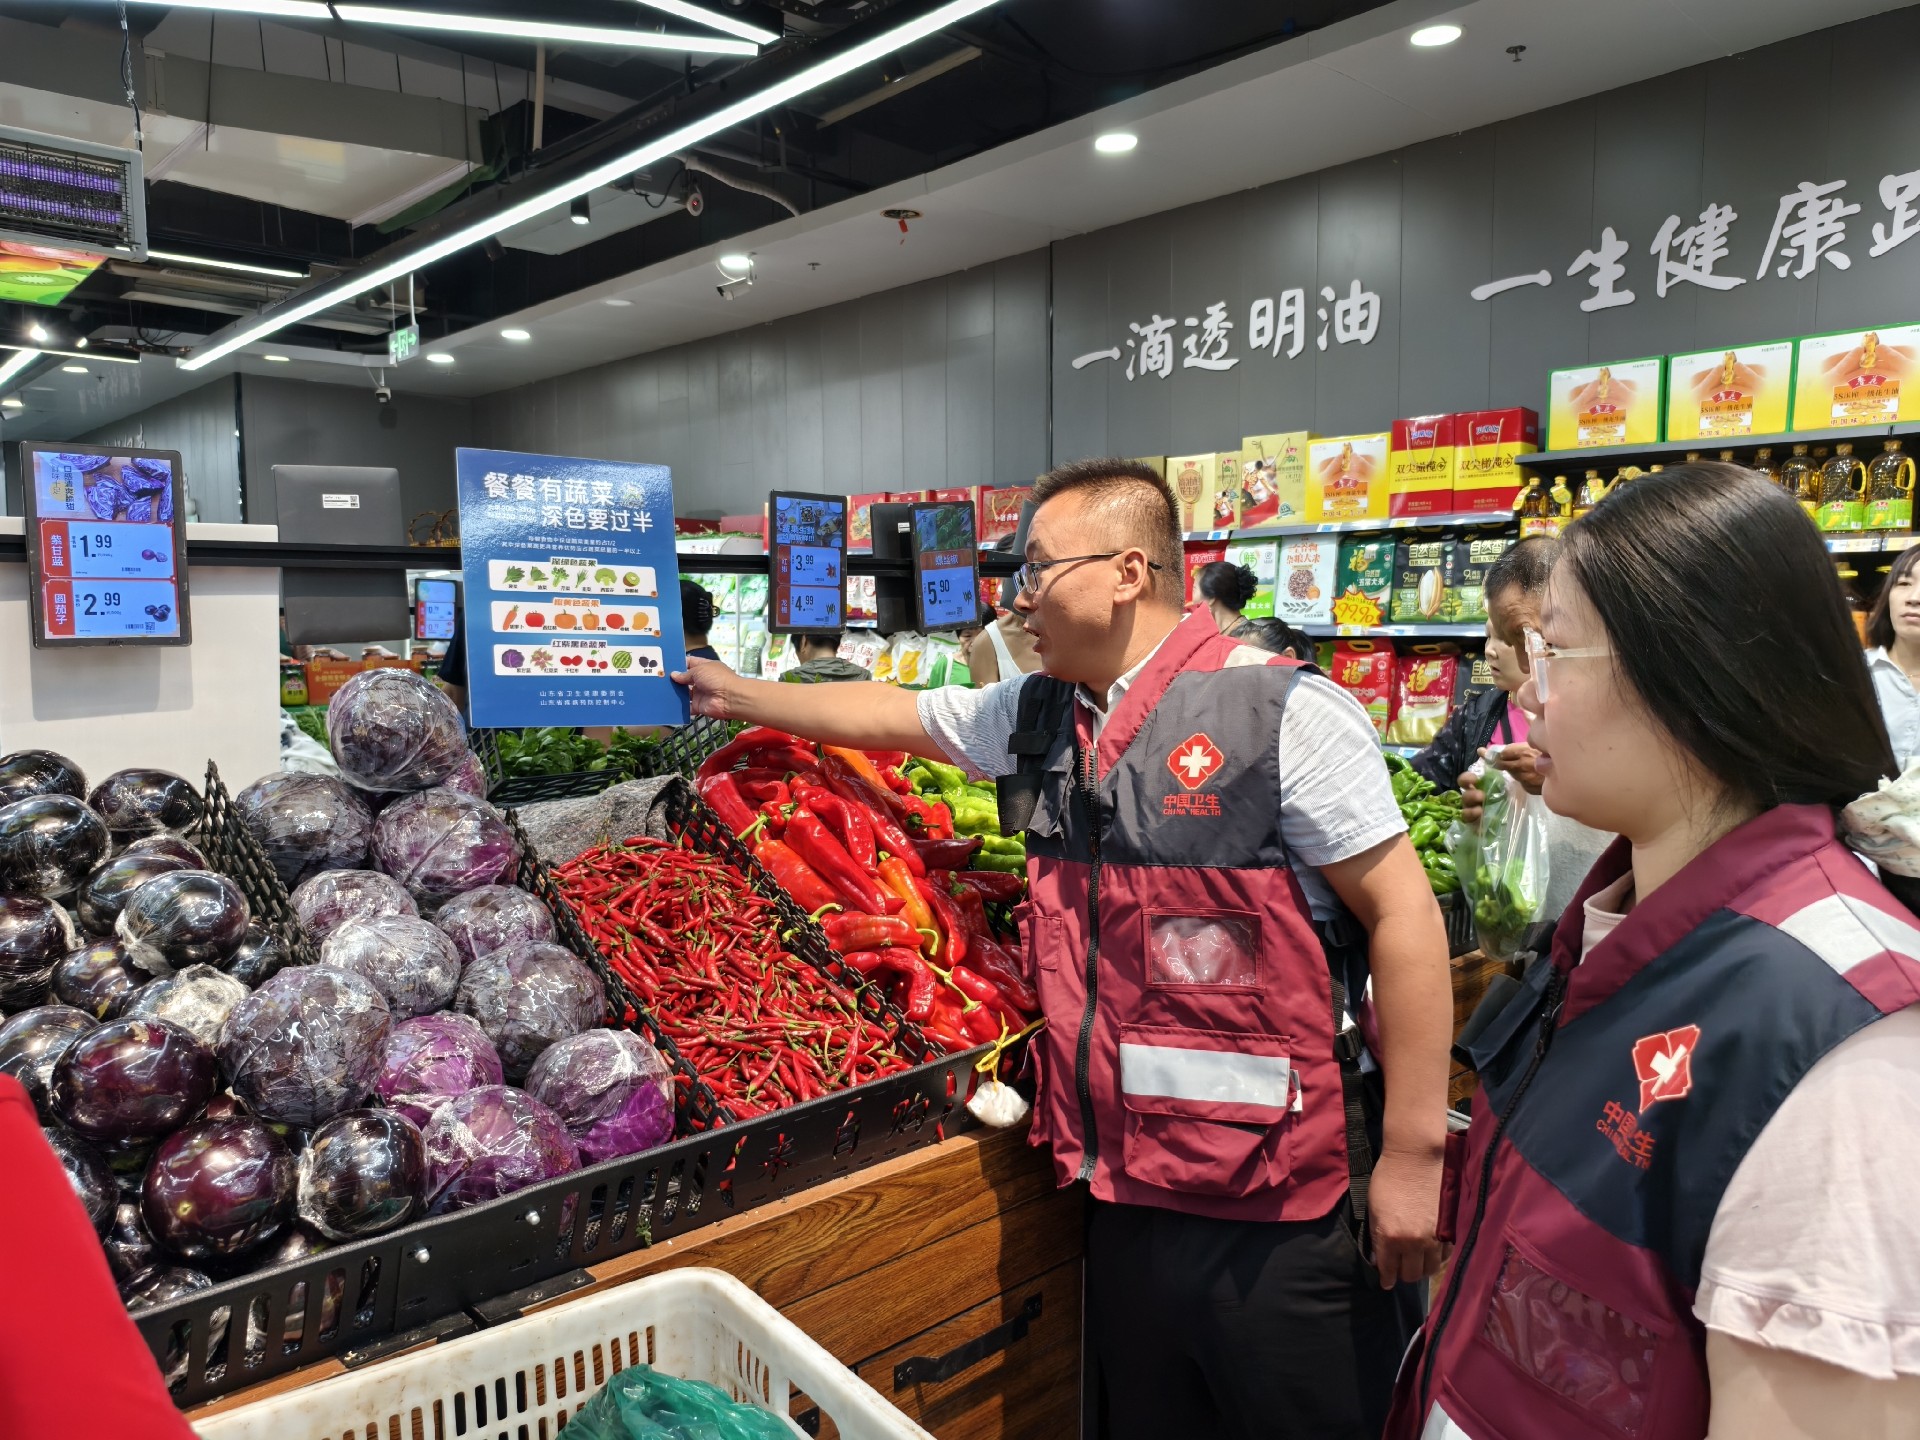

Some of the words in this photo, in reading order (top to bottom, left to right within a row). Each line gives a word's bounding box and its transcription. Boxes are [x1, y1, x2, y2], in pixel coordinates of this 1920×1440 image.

[1072, 279, 1381, 381] 一滴透明油
[484, 471, 615, 506] 餐餐有蔬菜
[541, 504, 653, 533] 深色要过半
[51, 535, 64, 566] 紫甘蓝
[80, 534, 112, 557] 1.99
[1408, 542, 1442, 558] 自然香
[1470, 539, 1506, 556] 自然香
[795, 554, 814, 571] 3.99
[935, 554, 959, 566] 螺丝椒
[927, 579, 950, 605] 5.90
[54, 593, 67, 625] 圆茄子
[83, 592, 120, 615] 2.99
[795, 595, 814, 611] 4.99
[552, 640, 607, 649] 红紫黑色蔬果
[1163, 793, 1221, 808] 中国卫生
[1190, 808, 1221, 816] HEALTH
